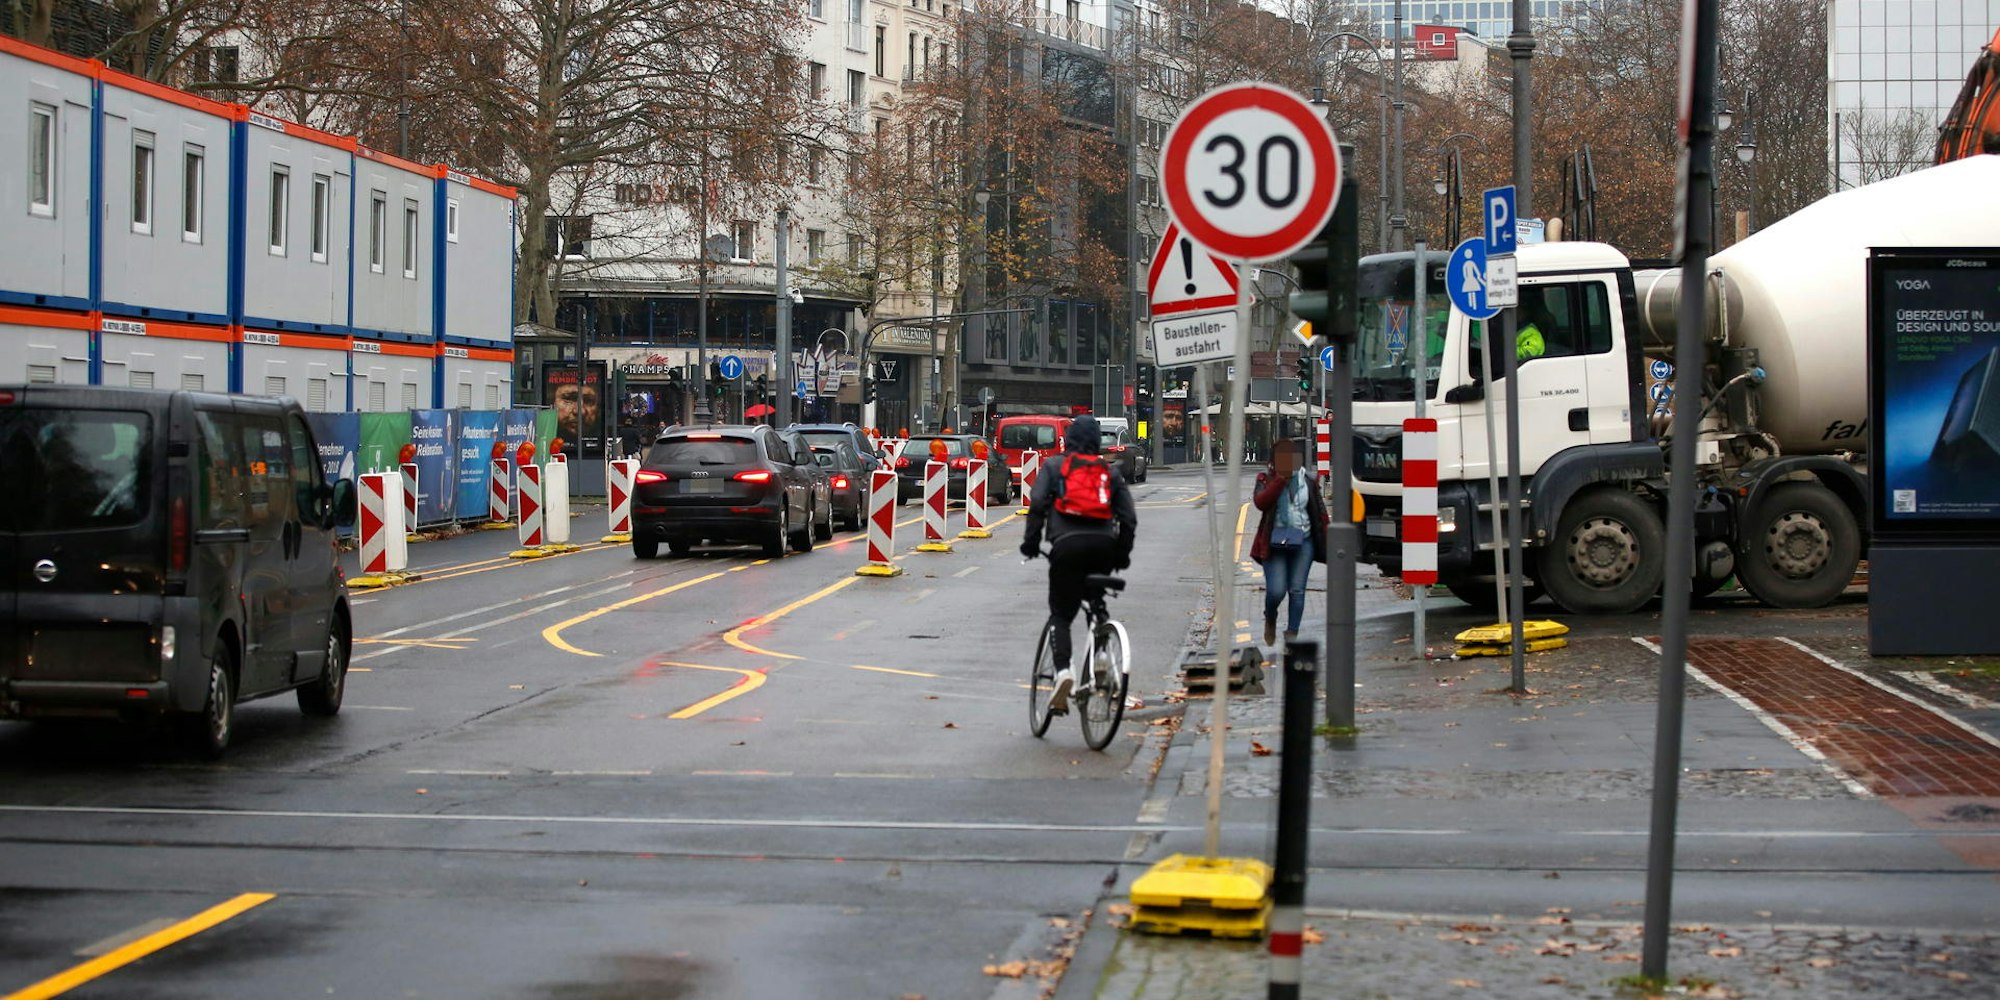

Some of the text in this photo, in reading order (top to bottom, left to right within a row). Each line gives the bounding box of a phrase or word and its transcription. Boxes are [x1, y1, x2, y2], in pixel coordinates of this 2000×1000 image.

[1203, 133, 1299, 210] 30
[1490, 196, 1509, 248] P
[1945, 259, 1988, 267] JCDecaux
[1896, 279, 1931, 290] YOGA
[1896, 309, 1985, 321] ÜBERZEUGT IN
[1164, 321, 1228, 341] Baustellen-
[1896, 322, 1941, 333] DESIGN
[1943, 322, 1972, 333] UND
[1175, 339, 1222, 357] ausfahrt
[622, 364, 671, 375] CHAMPS
[1364, 453, 1398, 468] MAN
